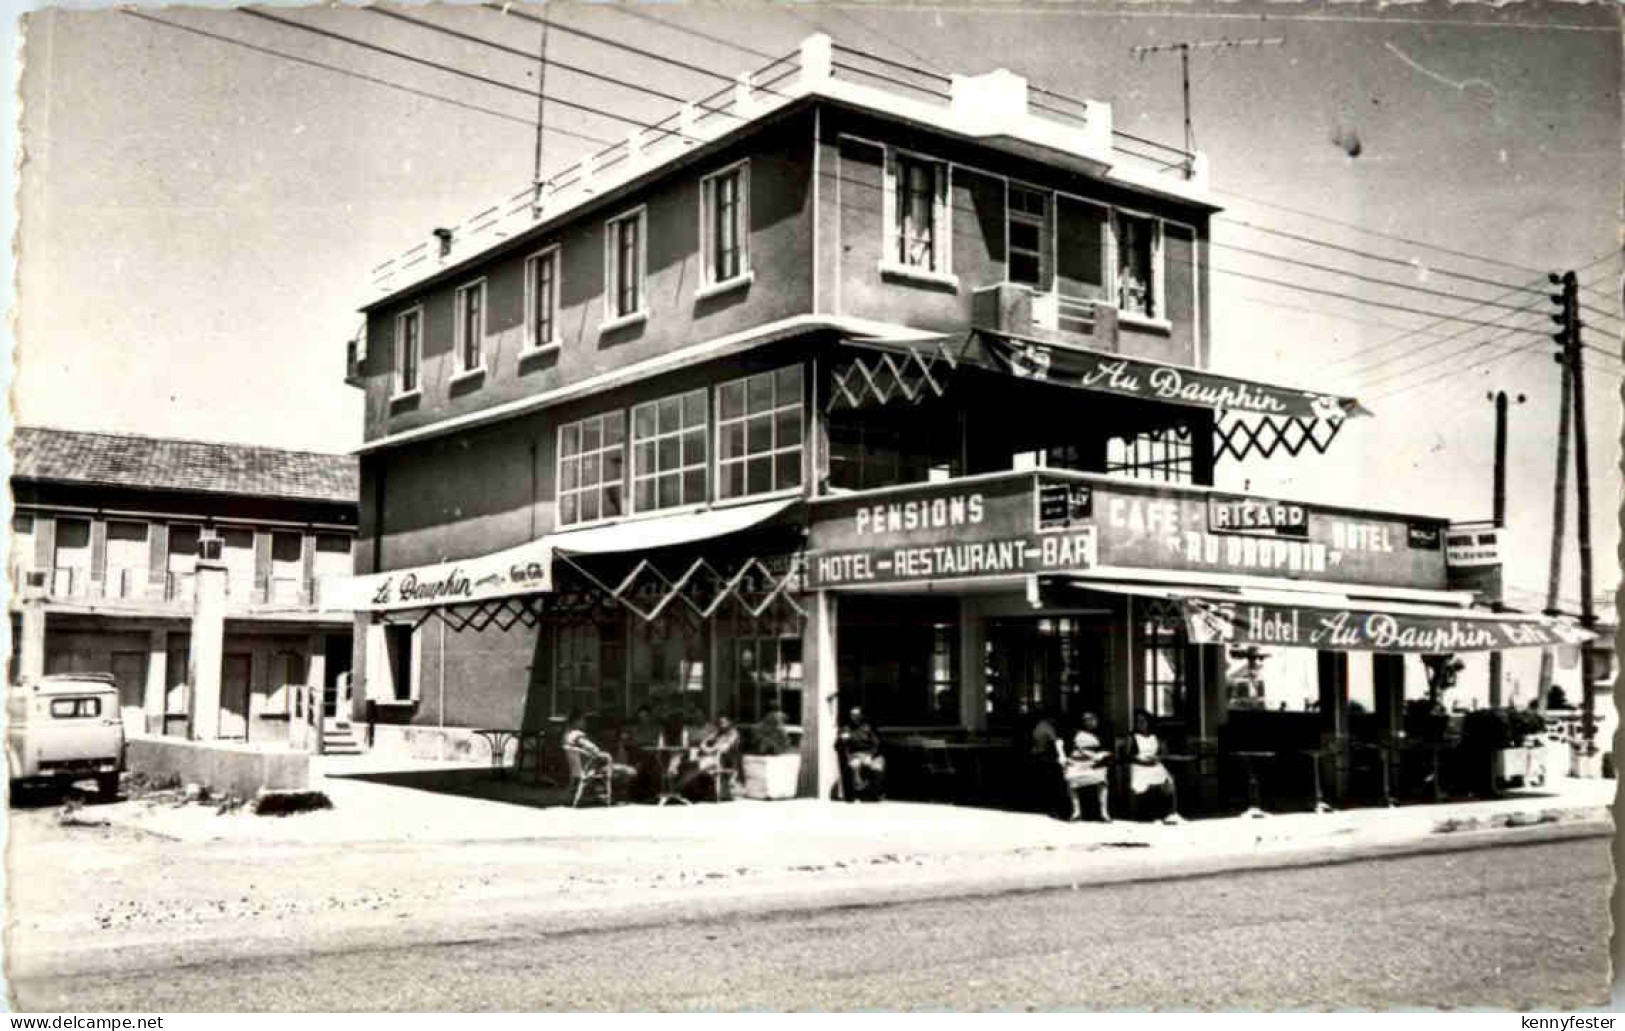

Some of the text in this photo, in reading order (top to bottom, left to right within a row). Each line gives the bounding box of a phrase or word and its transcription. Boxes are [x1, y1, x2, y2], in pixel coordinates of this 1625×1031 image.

[1083, 361, 1287, 414] Au Dauphin
[855, 494, 984, 535] PENSIONS
[1217, 503, 1304, 528] RICARD
[400, 568, 472, 601] Dauphin
[1248, 605, 1299, 642] Hotel
[1309, 611, 1361, 644] Au
[1365, 613, 1499, 652] Dauphin
